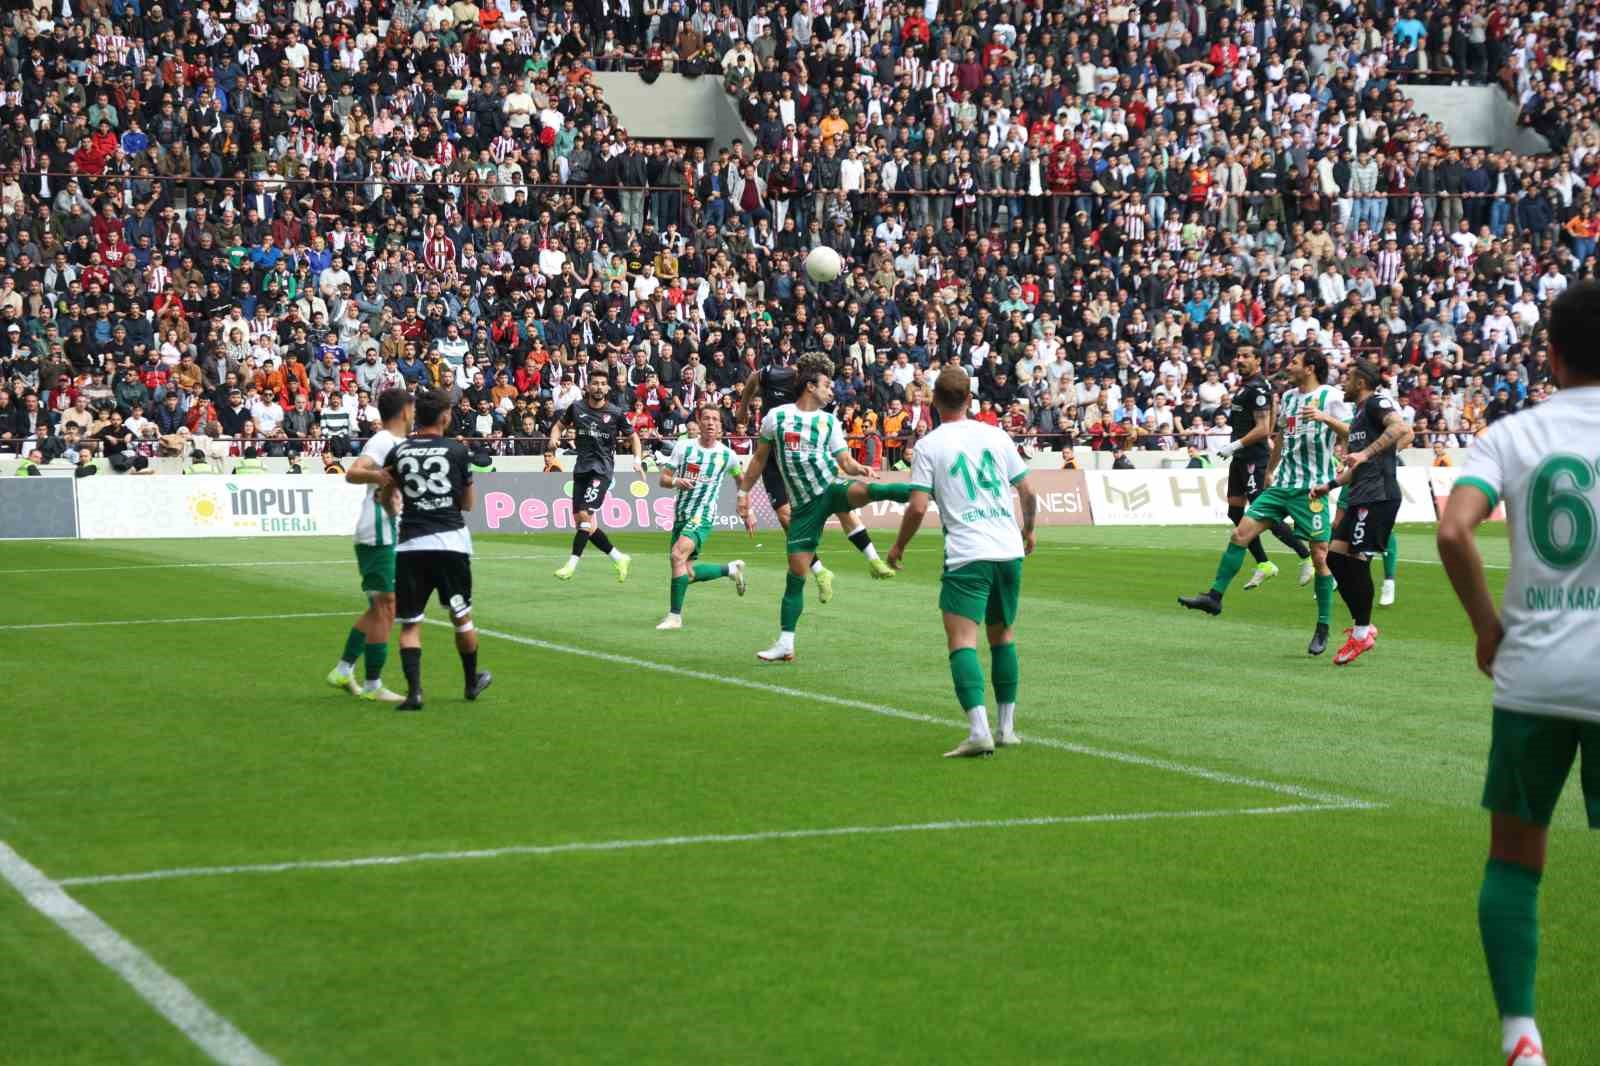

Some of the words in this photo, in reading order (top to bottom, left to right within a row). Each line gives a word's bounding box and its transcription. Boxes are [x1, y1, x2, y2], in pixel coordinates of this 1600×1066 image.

[398, 456, 452, 497] 33
[949, 449, 1003, 501] 14
[1247, 474, 1257, 489] 4
[584, 487, 599, 503] 35
[1035, 487, 1083, 513] NESİ
[1526, 452, 1600, 571] 6
[1354, 522, 1365, 539] 5
[1526, 586, 1564, 610] ONUR
